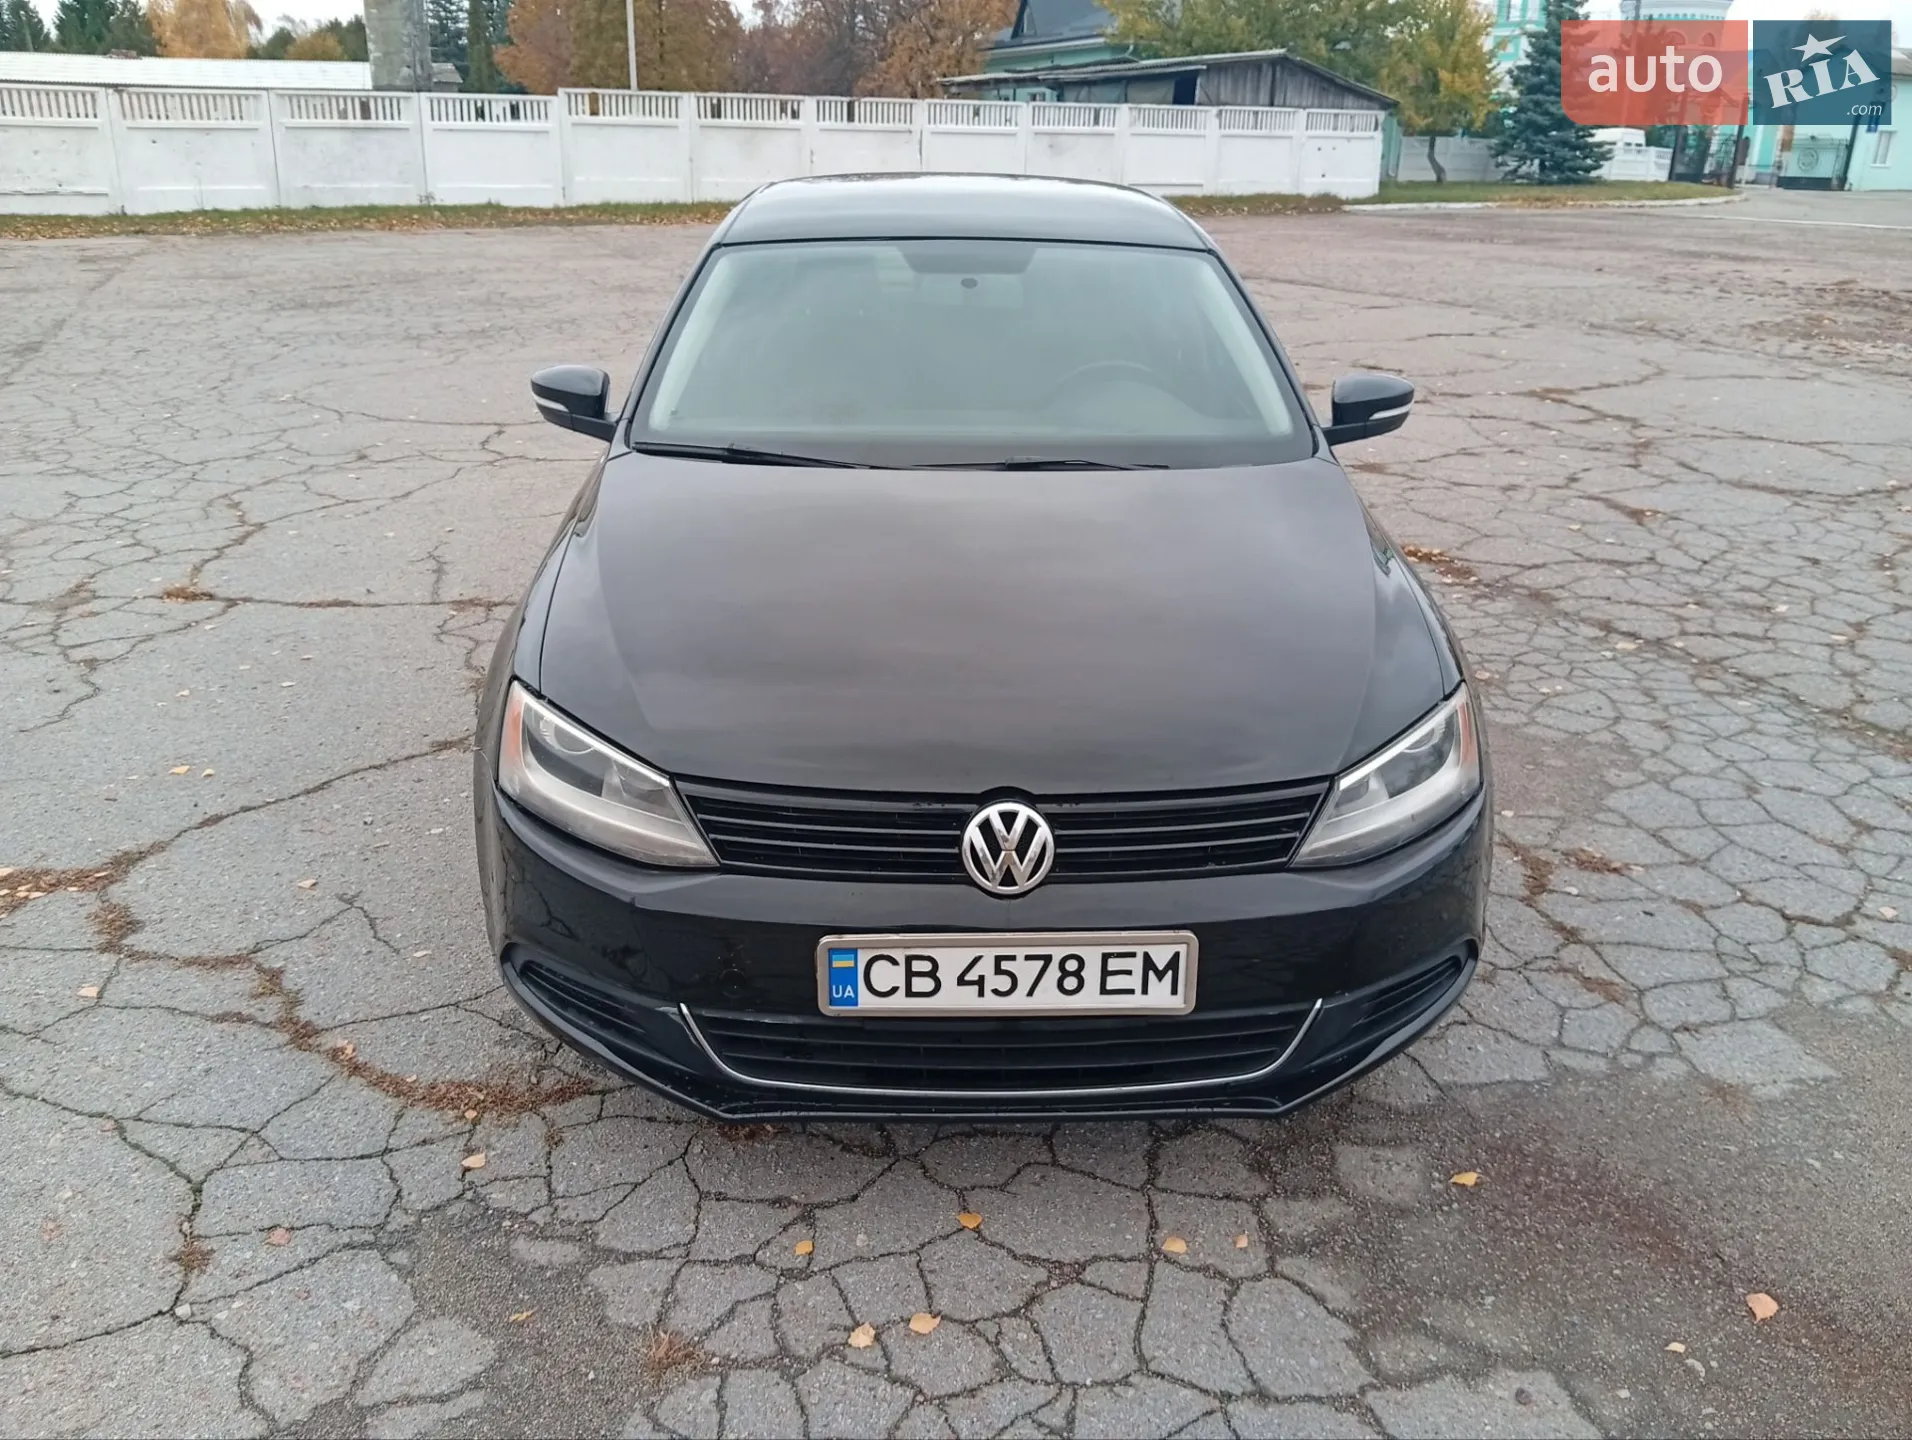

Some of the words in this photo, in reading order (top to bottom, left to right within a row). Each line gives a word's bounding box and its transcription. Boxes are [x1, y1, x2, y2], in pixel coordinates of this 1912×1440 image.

[863, 954, 942, 998] CB
[956, 953, 1086, 998] 4578
[1100, 951, 1181, 996] EM
[832, 984, 855, 999] UA
